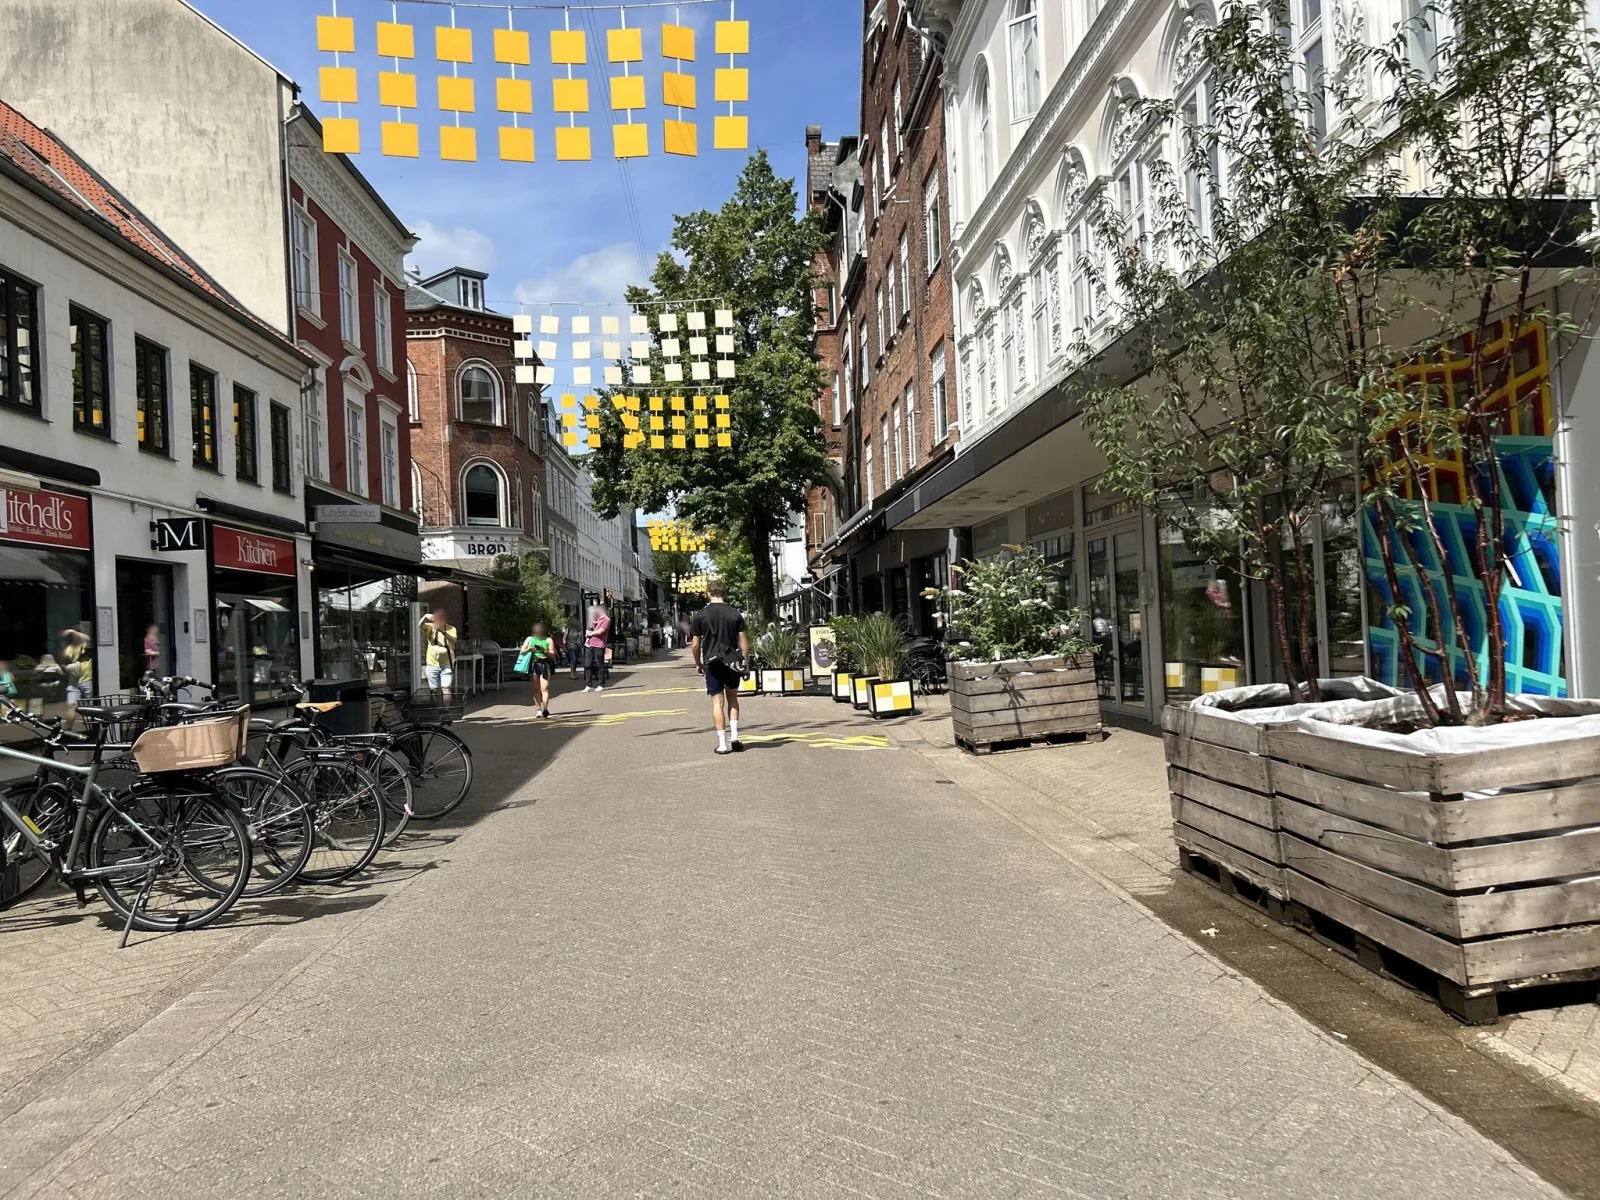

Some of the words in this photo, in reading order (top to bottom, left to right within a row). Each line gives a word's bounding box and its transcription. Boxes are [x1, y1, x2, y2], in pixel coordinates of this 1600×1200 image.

[0, 489, 72, 532] itchell's
[160, 520, 198, 548] M
[237, 535, 277, 567] Kitchen
[468, 544, 506, 555] BRØD
